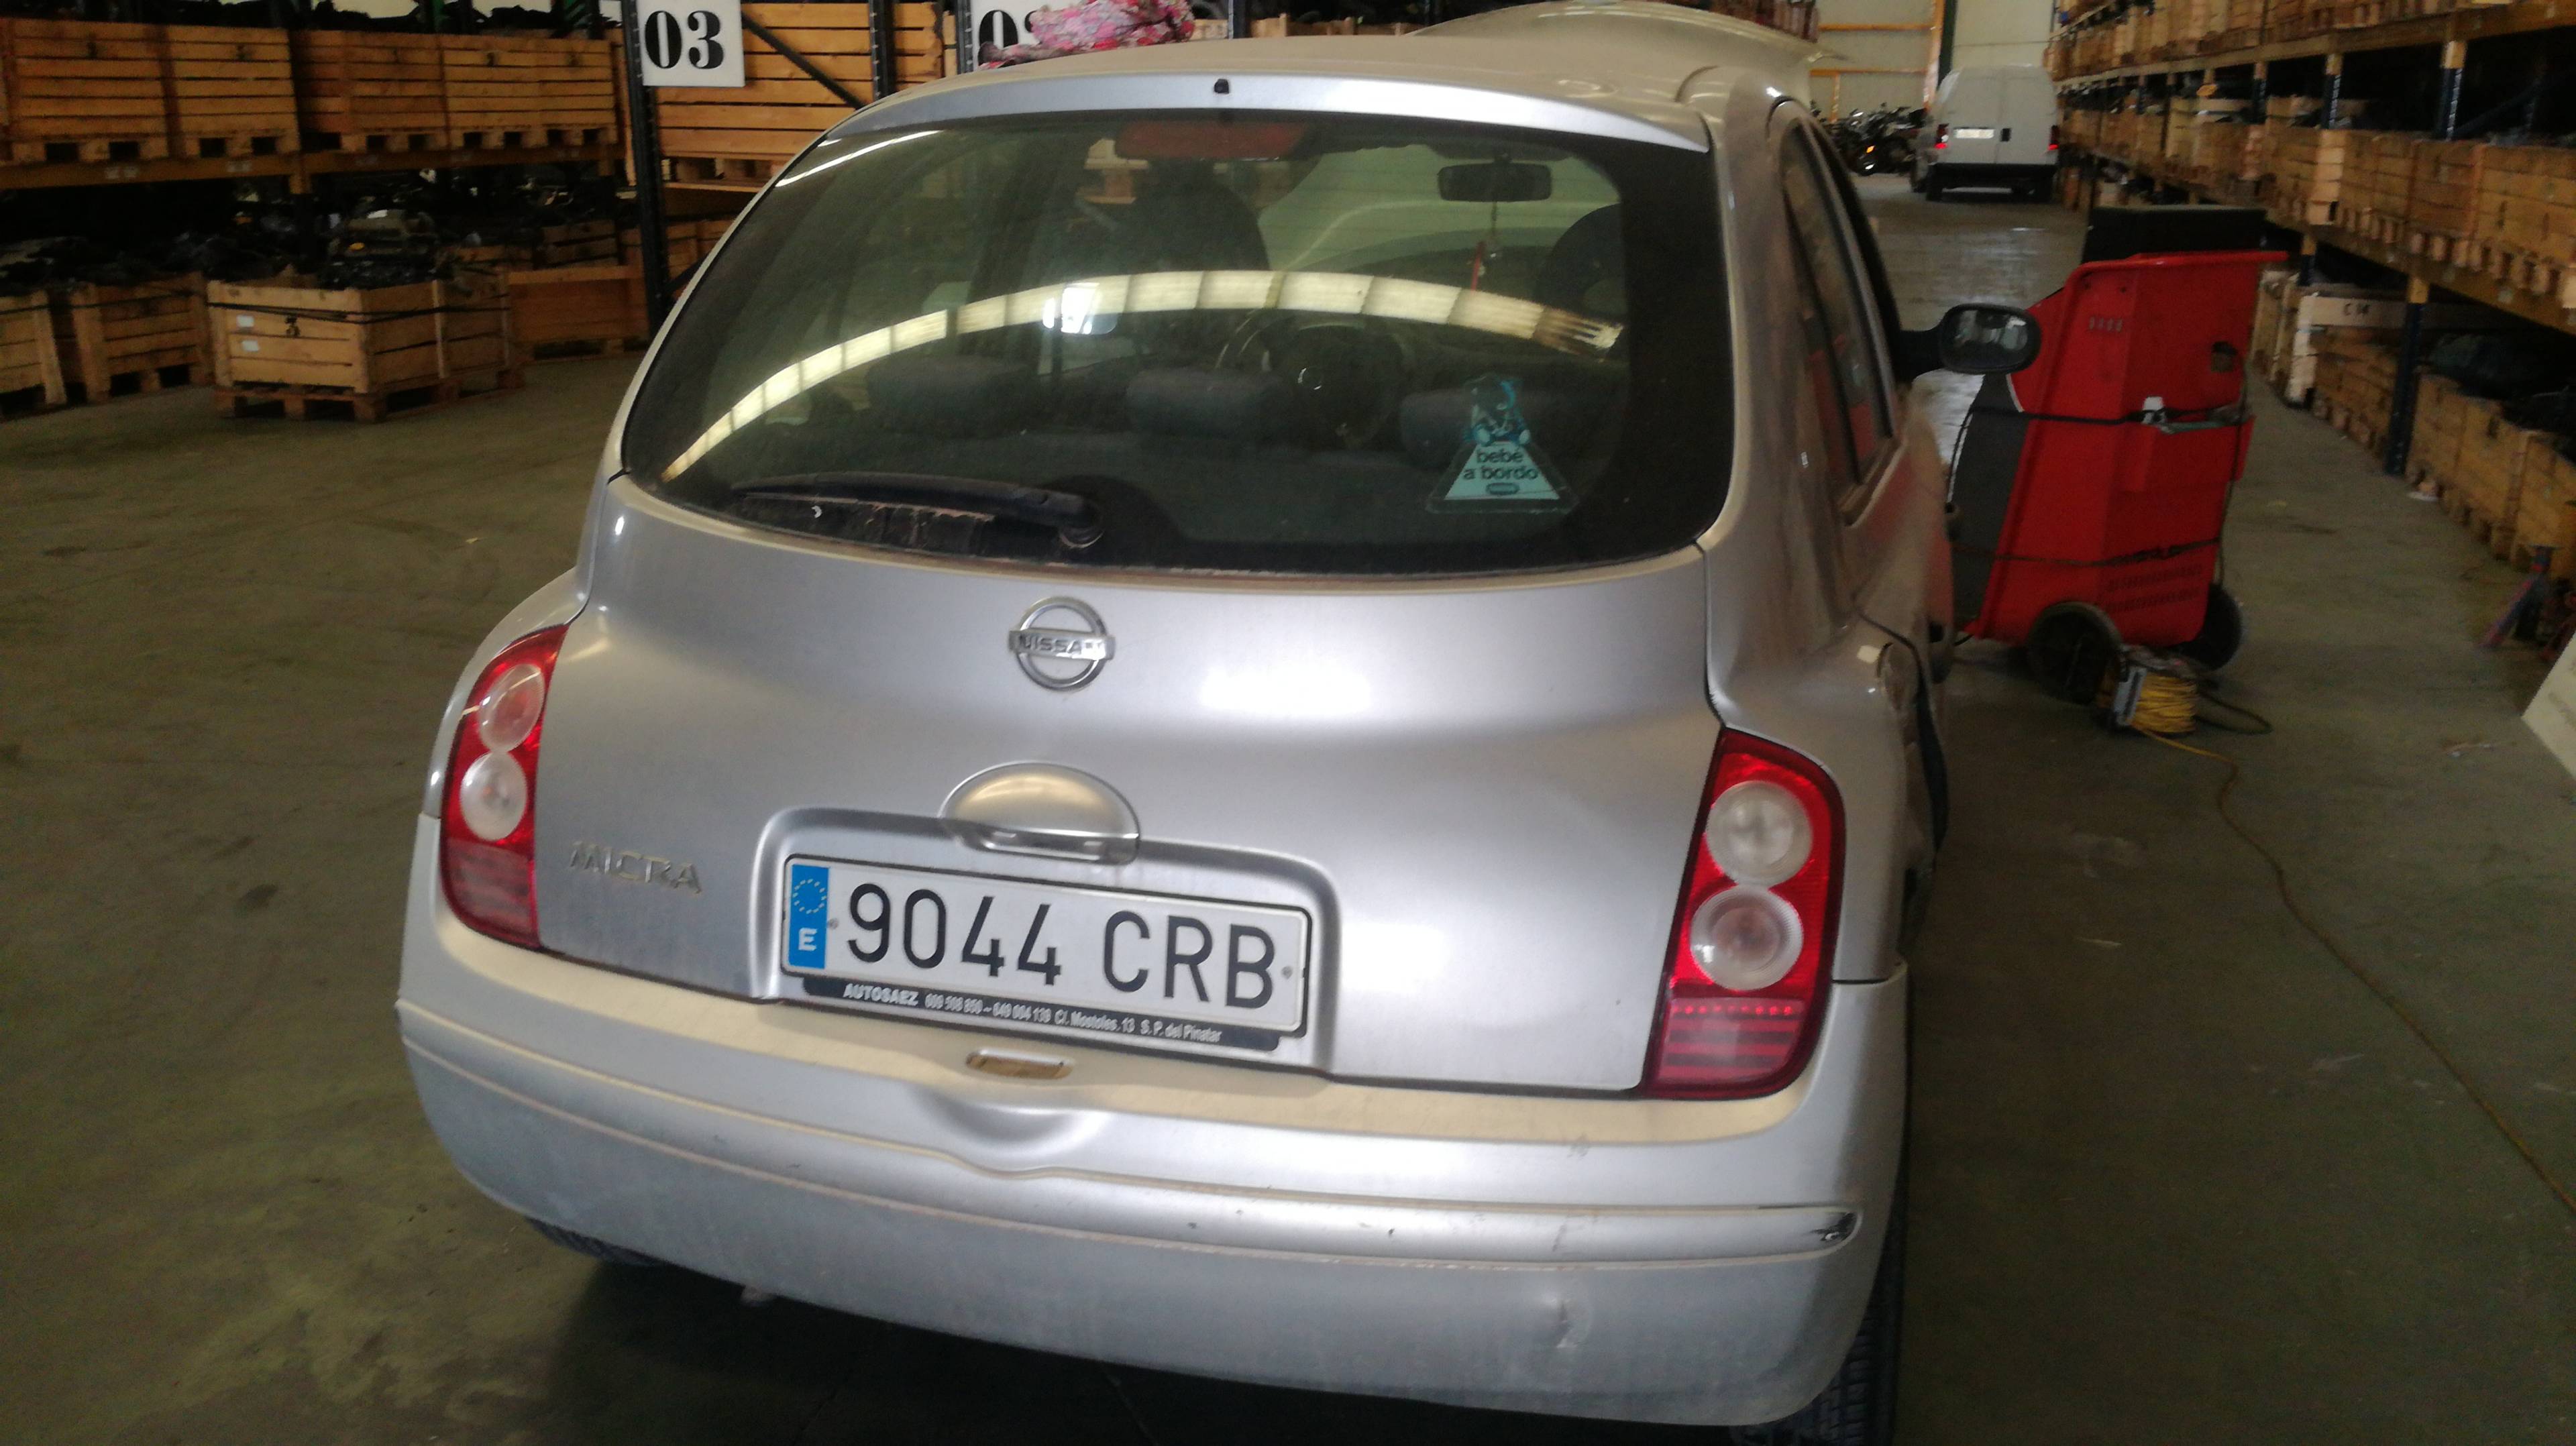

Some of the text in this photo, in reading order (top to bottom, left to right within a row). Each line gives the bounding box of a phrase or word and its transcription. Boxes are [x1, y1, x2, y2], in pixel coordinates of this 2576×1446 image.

[645, 10, 724, 69] 03
[978, 9, 1037, 66] 0
[1463, 465, 1539, 480] a bordo
[798, 928, 817, 951] E
[848, 883, 1275, 1009] 9044 CRB
[843, 983, 919, 1006] AUTOSAEZ
